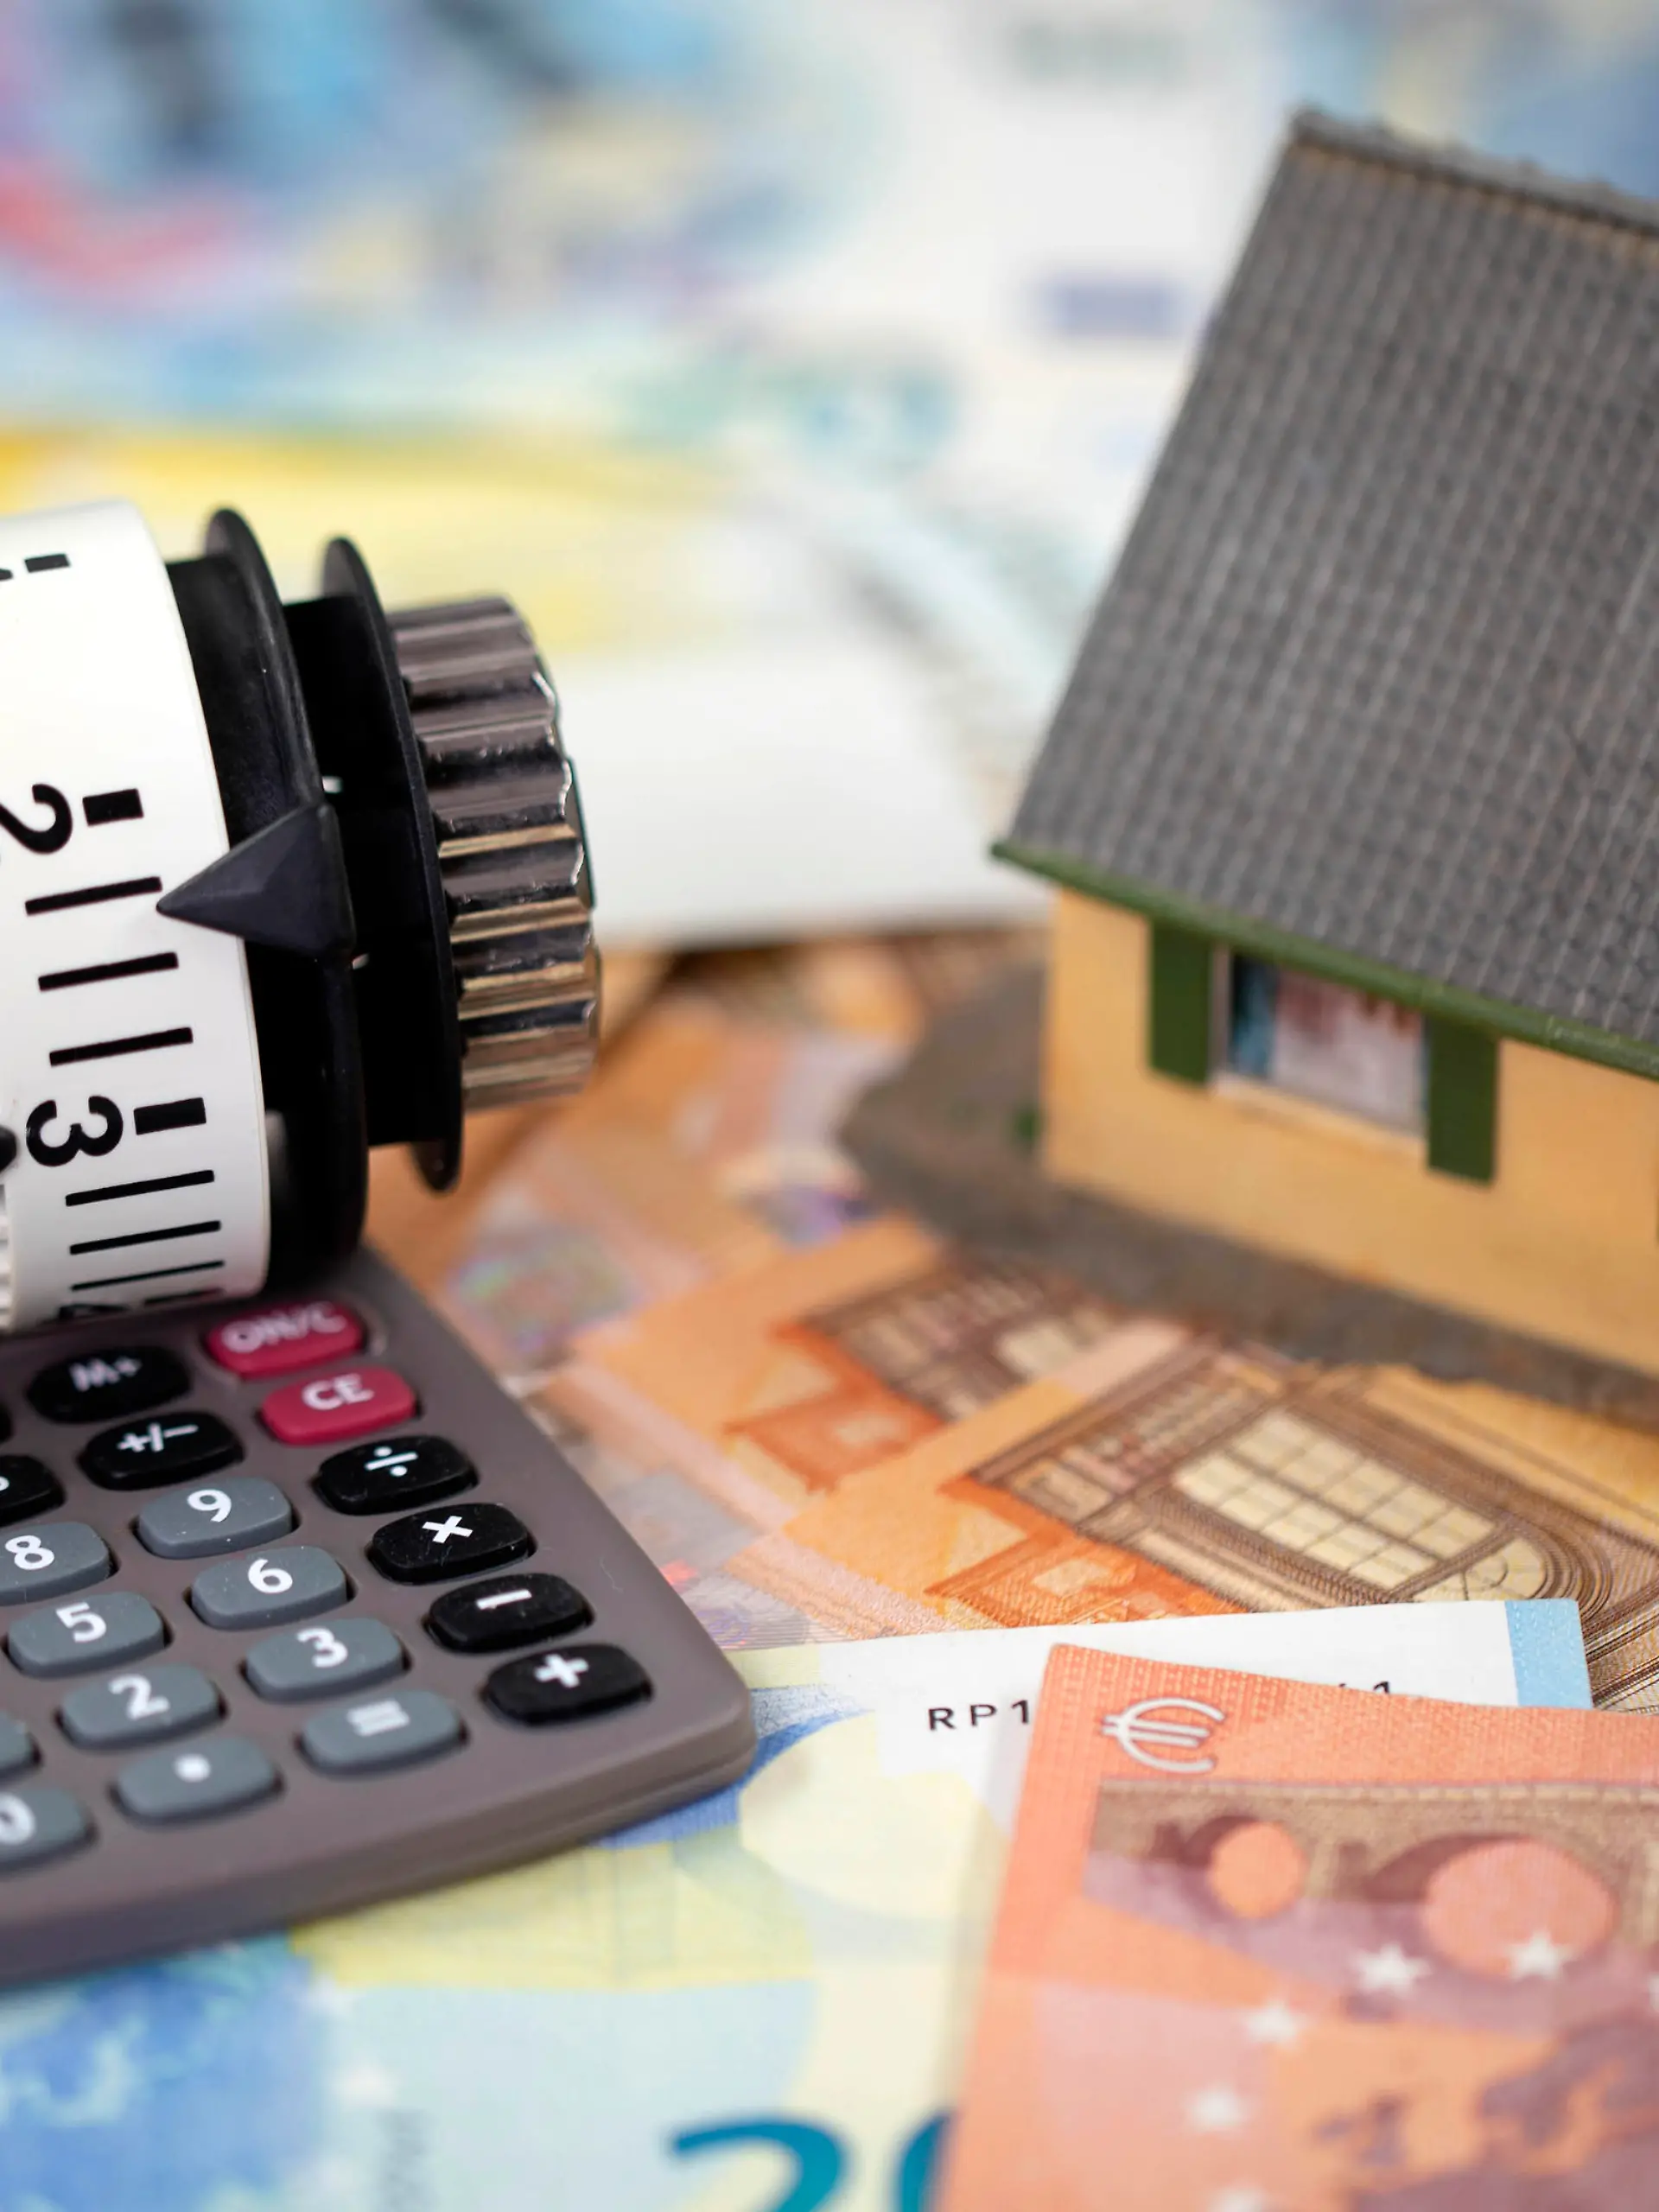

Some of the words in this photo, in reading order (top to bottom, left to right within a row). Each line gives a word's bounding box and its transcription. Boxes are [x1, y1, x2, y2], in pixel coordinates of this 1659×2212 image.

[0, 783, 73, 855] 2
[26, 1095, 124, 1166] 3
[302, 1372, 374, 1410] CE
[187, 1489, 232, 1522] 9
[5, 1535, 54, 1570] 8
[247, 1559, 294, 1594] 6
[55, 1602, 107, 1643] 5
[296, 1627, 348, 1669] 3
[108, 1673, 170, 1720] 2
